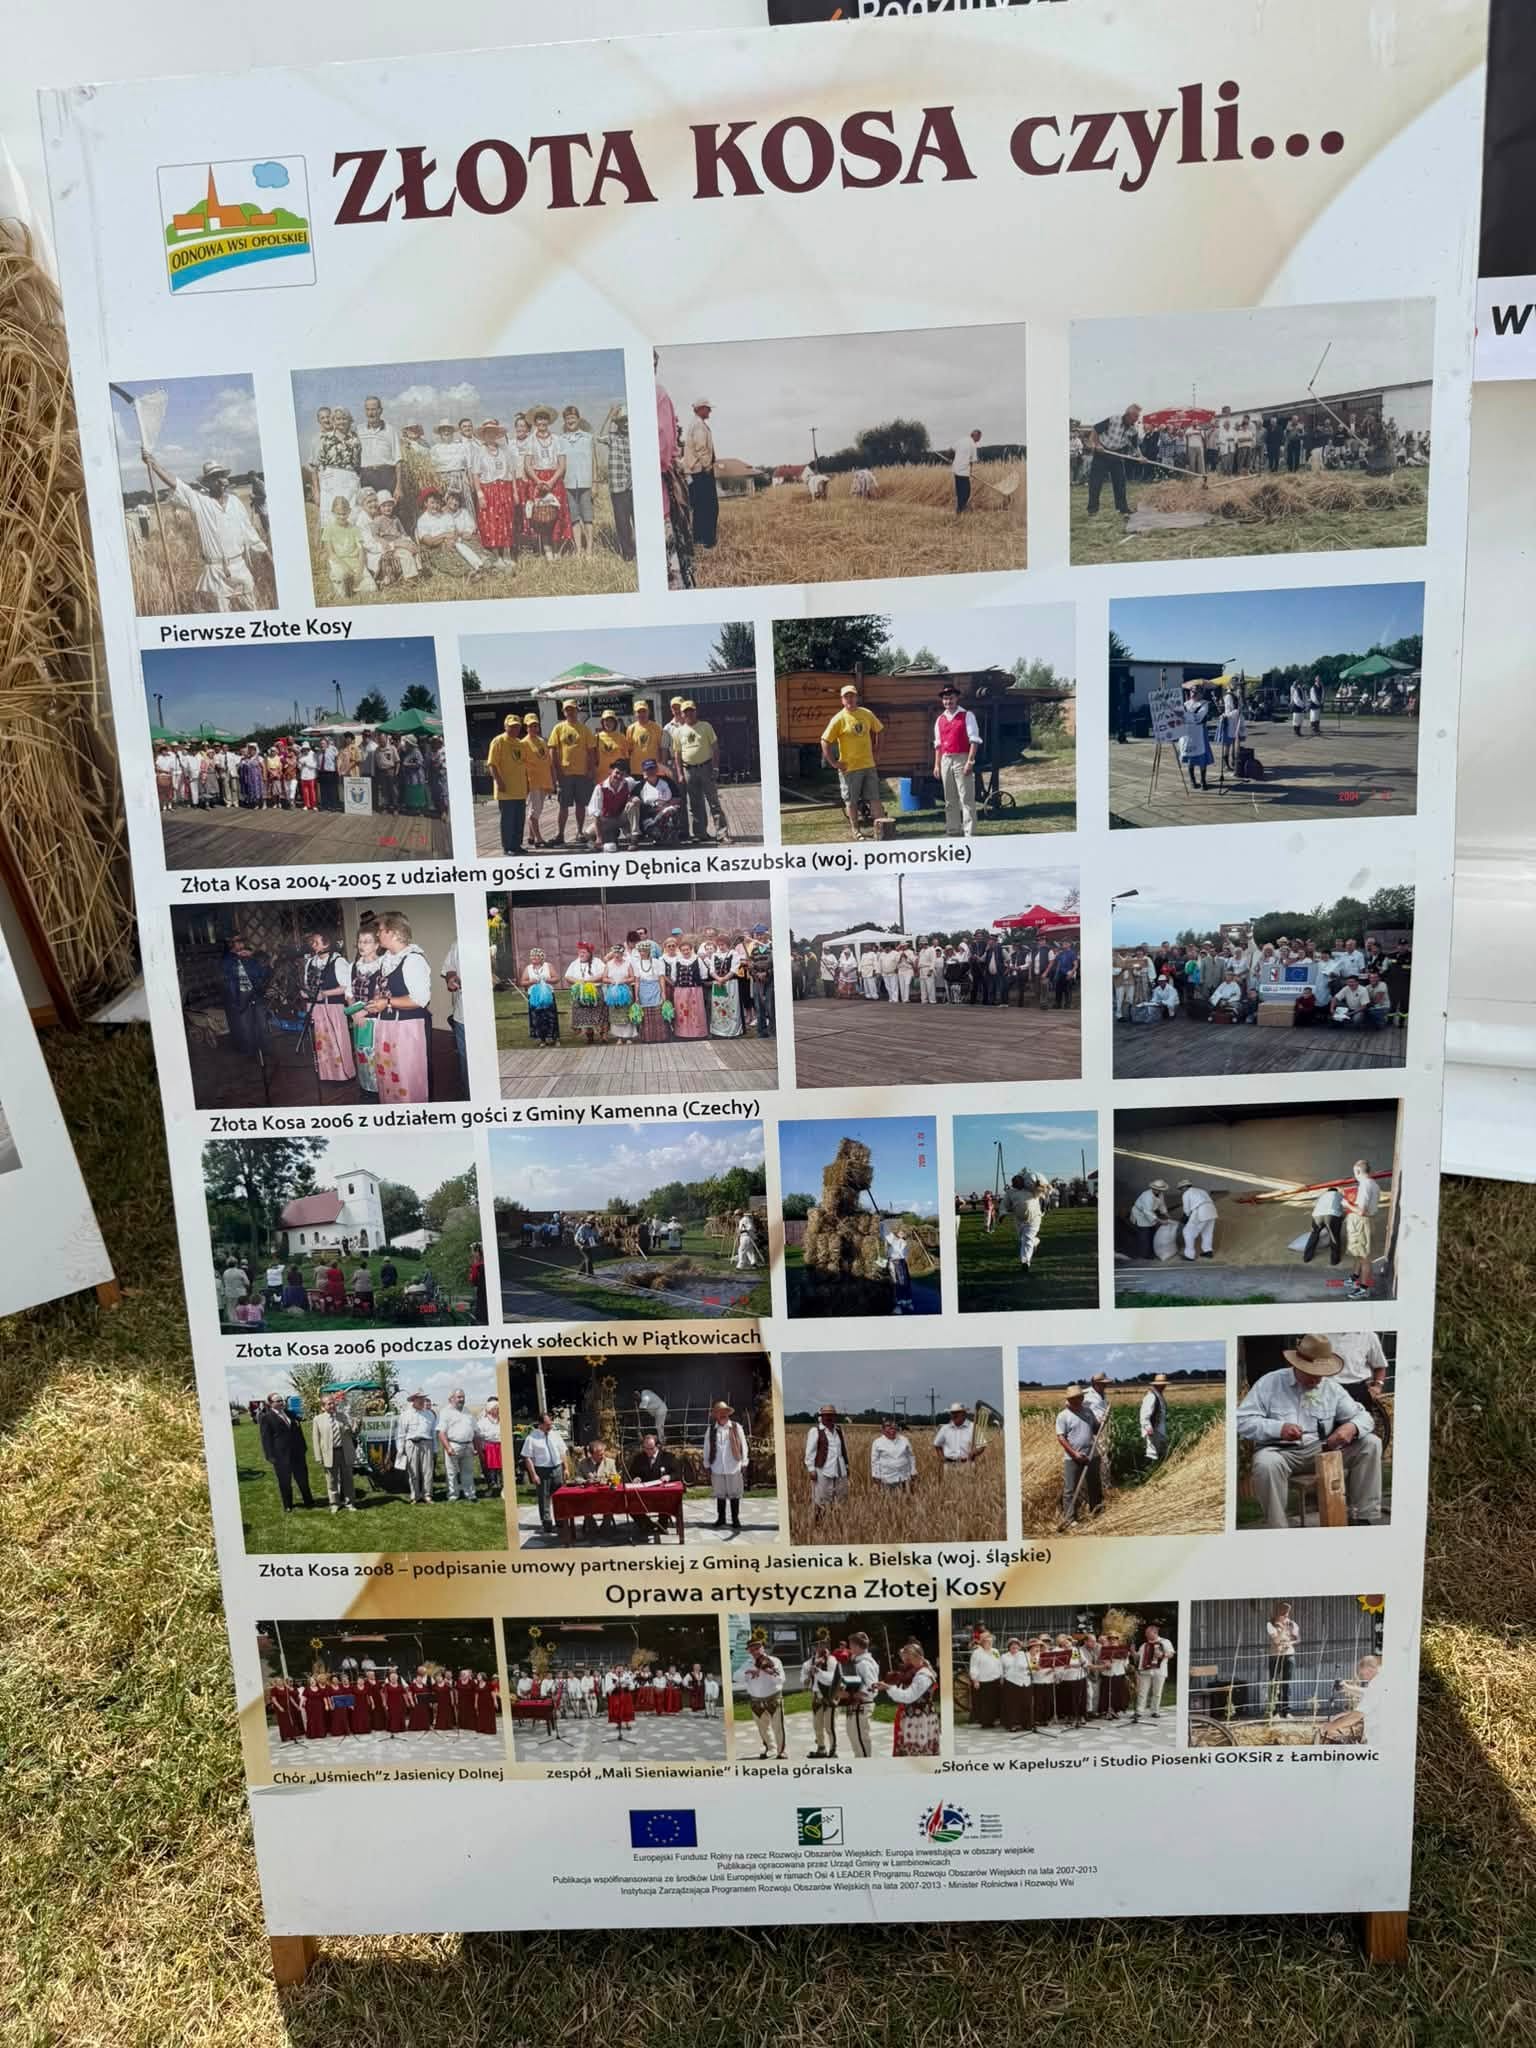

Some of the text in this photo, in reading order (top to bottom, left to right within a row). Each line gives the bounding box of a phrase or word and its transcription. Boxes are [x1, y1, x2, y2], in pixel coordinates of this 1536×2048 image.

[332, 80, 1344, 225] ZŁOTA KOSA czyli...
[172, 244, 224, 269] ODNOWA
[228, 239, 248, 252] WSI
[1491, 304, 1536, 335] w
[160, 618, 352, 644] Pierwsze Złote Kosy
[180, 844, 971, 893] Złota Kosa 2004-2005 z udziałem gości z Gminy Dębnica Kaszubska (woj. pomorskie)
[210, 1098, 759, 1132] Złota Kosa 2006 z udziałem gości z Gminy Kamenna (Czechy)
[235, 1324, 761, 1358] Złota Kosa 2006 podczas dożynek sołeckich w Piątkowicach
[258, 1563, 303, 1577] Złota
[308, 1563, 349, 1576] Kosa
[354, 1562, 394, 1576] 2008
[413, 1559, 506, 1579] podpisanie
[512, 1562, 575, 1576] umowy
[580, 1555, 684, 1576] partnerskiej
[689, 1559, 698, 1569] z
[702, 1554, 759, 1573] Gminą
[764, 1553, 842, 1568] Jasienica
[848, 1552, 863, 1567] k.
[869, 1551, 932, 1566] Bielska
[937, 1549, 980, 1568] (woj.
[986, 1547, 1051, 1567] śląskie)
[606, 1577, 1006, 1608] Oprawa artystyczna Złotej Kosy
[546, 1767, 591, 1781] zespół
[735, 1765, 738, 1776] i
[742, 1764, 788, 1779] kapela
[792, 1763, 852, 1778] góralska
[992, 1762, 1005, 1770] w
[1093, 1756, 1096, 1767] i
[1100, 1754, 1147, 1767] Studio
[1151, 1752, 1211, 1765] Piosenki
[1214, 1751, 1272, 1763] GOKSiR
[1276, 1754, 1284, 1762] z
[1290, 1749, 1378, 1762] Łambinowic
[273, 1772, 306, 1784] Chór
[393, 1768, 454, 1782] Jasienicy
[458, 1767, 503, 1782] Dolnej
[633, 1853, 673, 1863] Europejski
[710, 1852, 732, 1861] Rolny
[768, 1850, 802, 1859] Rozwoju
[803, 1850, 842, 1858] Obszarów
[885, 1848, 914, 1857] Europa
[971, 1848, 1002, 1856] obszary
[717, 1862, 756, 1870] Publikacja
[806, 1861, 828, 1869] przez
[830, 1859, 853, 1868] Urząd
[855, 1859, 880, 1868] Gminy
[552, 1876, 591, 1884] Publikacja
[726, 1872, 773, 1882] Europejskiej
[814, 1870, 828, 1879] Osi
[836, 1870, 871, 1878] LEADER
[872, 1870, 911, 1879] Programu
[912, 1869, 946, 1877] Rozwoju
[948, 1869, 987, 1877] Obszarów
[989, 1868, 1026, 1876] Wiejskich
[1056, 1865, 1097, 1874] 2007-2013
[620, 1887, 656, 1896] Instytucja
[712, 1885, 756, 1894] Programem
[758, 1884, 791, 1892] Rozwoju
[792, 1883, 832, 1891] Obszarów
[833, 1882, 870, 1891] Wiejskich
[900, 1881, 941, 1889] 2007-2013
[980, 1880, 1018, 1888] Rolnictwa
[1024, 1879, 1058, 1887] Rozwoju
